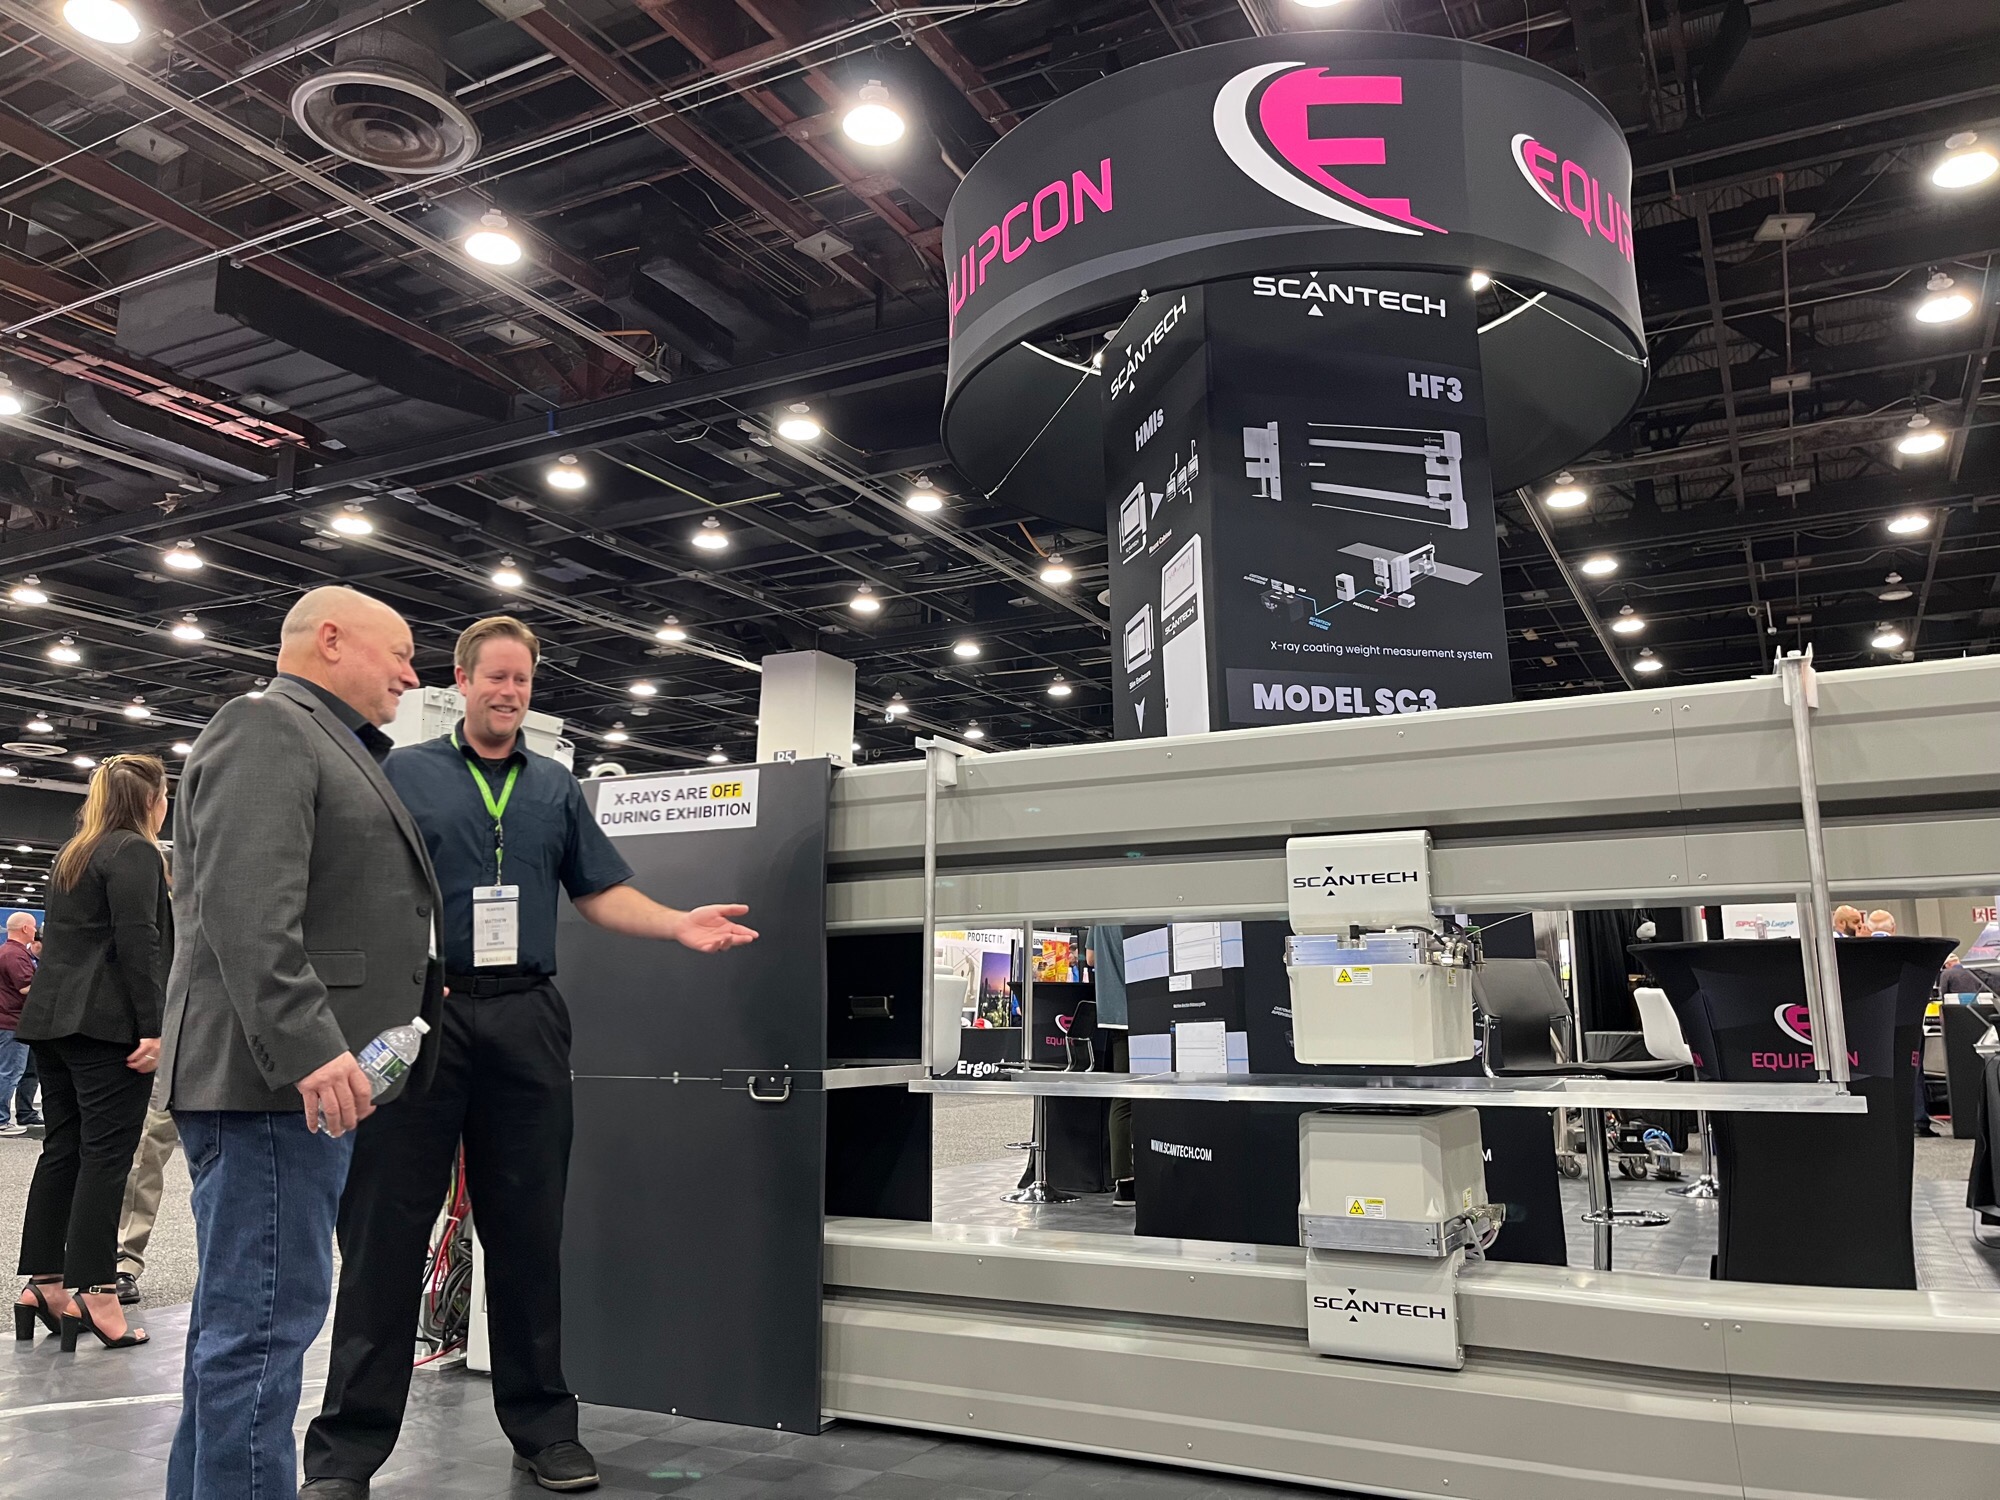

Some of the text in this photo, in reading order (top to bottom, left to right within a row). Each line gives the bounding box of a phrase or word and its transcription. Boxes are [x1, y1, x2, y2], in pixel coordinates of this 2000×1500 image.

[1253, 276, 1446, 318] SCANTECH
[1110, 295, 1187, 400] SCANTECH
[1408, 372, 1463, 403] HF3
[1165, 605, 1195, 636] SCANTECH
[1270, 641, 1493, 661] X-ray coating weight measurement system
[1252, 683, 1438, 715] MODEL SC3
[614, 783, 742, 806] X-RAYS ARE OFF
[601, 802, 752, 826] DURING EXHIBITION
[1293, 871, 1418, 889] SCANTECH
[967, 931, 996, 944] PROTECT
[1751, 1051, 1859, 1072] EQUIPN
[1150, 1138, 1213, 1162] WWW.SCANTECH.COM
[1313, 1296, 1446, 1320] SCANTECH
